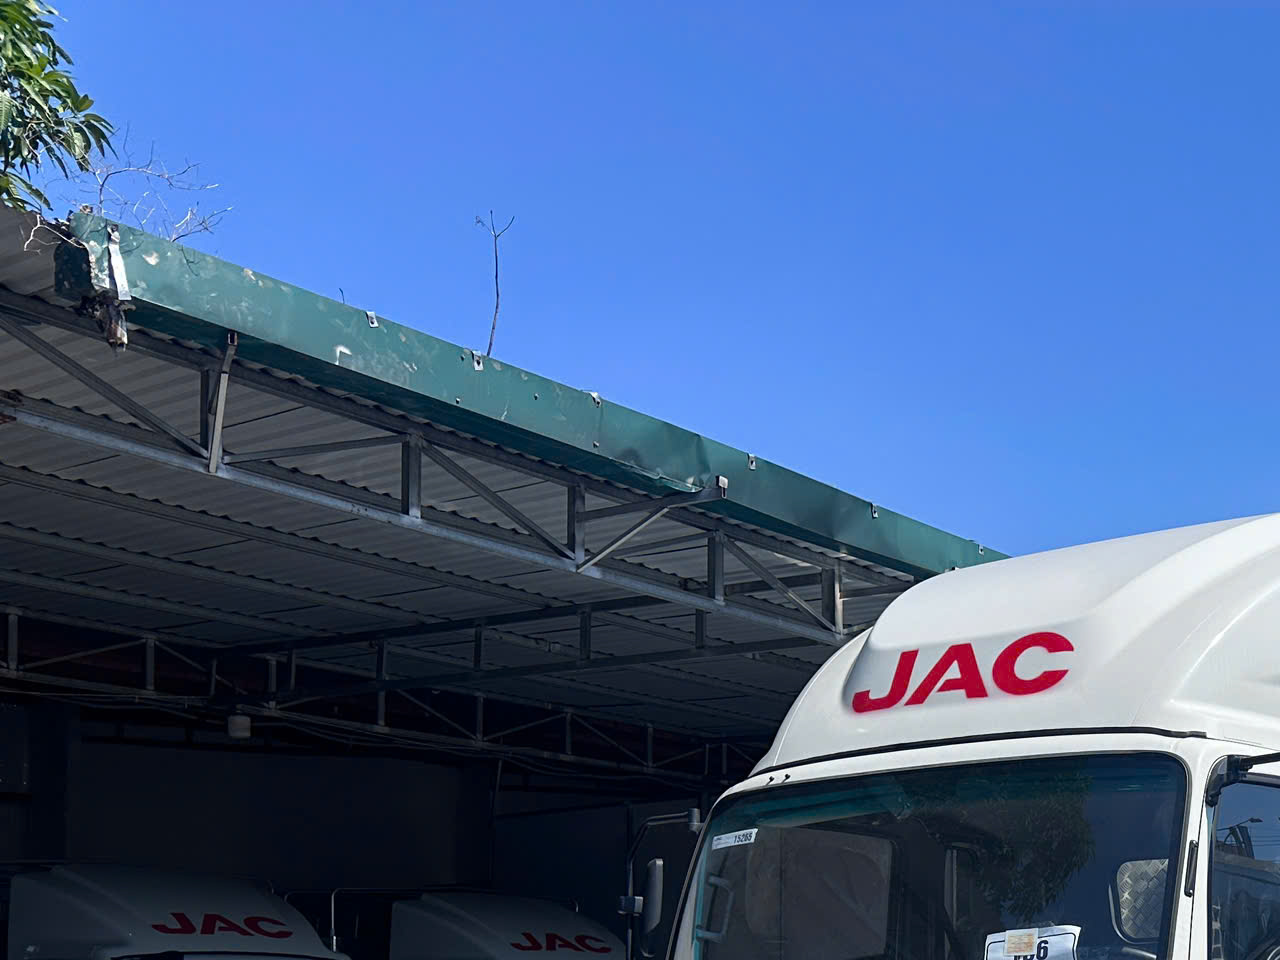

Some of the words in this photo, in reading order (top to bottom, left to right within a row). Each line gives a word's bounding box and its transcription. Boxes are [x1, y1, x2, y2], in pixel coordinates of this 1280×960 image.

[852, 632, 1075, 713] JAC
[152, 912, 294, 939] JAC
[510, 932, 613, 953] JAC
